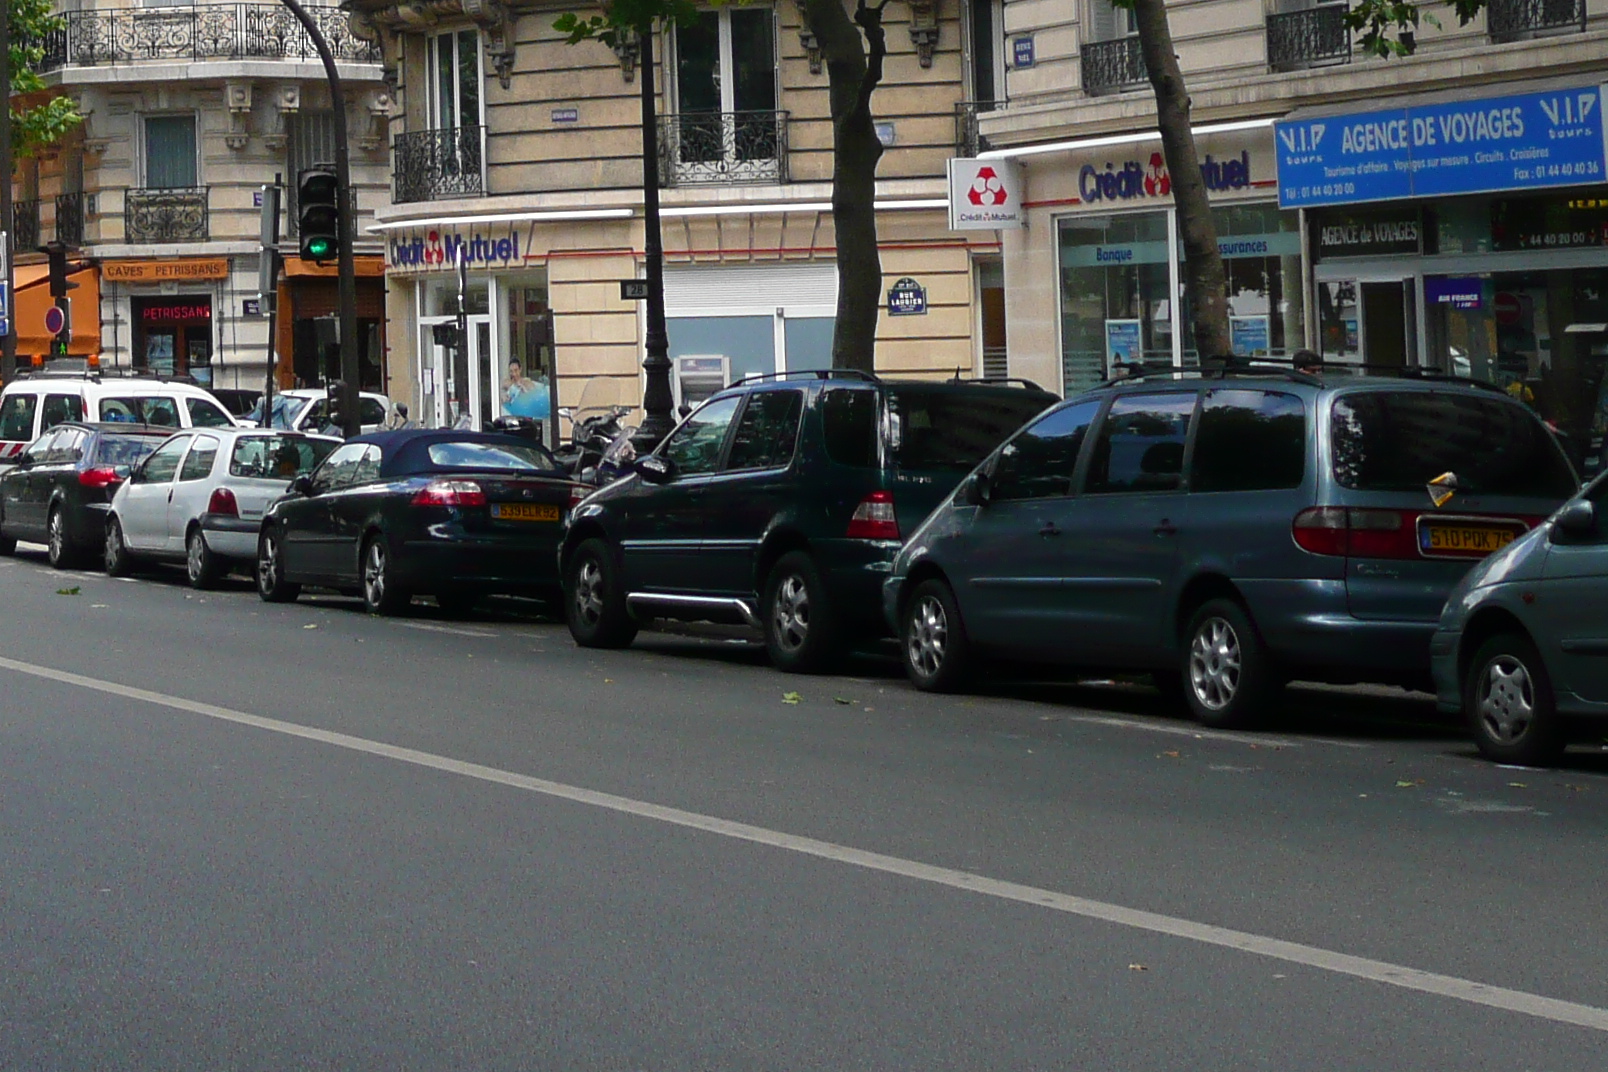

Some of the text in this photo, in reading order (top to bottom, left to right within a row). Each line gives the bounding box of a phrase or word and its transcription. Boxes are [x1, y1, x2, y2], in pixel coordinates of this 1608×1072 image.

[1342, 106, 1525, 154] AGENCE DE VOYAGES
[1548, 127, 1593, 139] tours
[1286, 154, 1323, 165] tours
[1475, 150, 1504, 164] Circuits
[1079, 150, 1251, 203] Crédit tuel
[1514, 167, 1529, 180] Fax
[1548, 164, 1559, 176] 44
[1561, 163, 1572, 176] 40
[1574, 162, 1585, 175] 40
[1587, 161, 1599, 174] 36
[1312, 186, 1322, 197] 44
[1323, 185, 1333, 196] 40
[1334, 184, 1343, 195] 20
[1344, 183, 1355, 194] 00
[960, 211, 1016, 222] Crédit Mutuel
[1321, 221, 1417, 245] AGENCE de VOYAGES
[1530, 235, 1542, 246] 44
[1544, 234, 1556, 245] 40
[1572, 232, 1585, 243] 00
[444, 231, 519, 263] Mutuel
[1218, 240, 1267, 255] ssurances
[1096, 246, 1133, 263] Banque
[107, 264, 220, 277] CAVES PETRISSANS
[1451, 294, 1478, 302] FRANCE
[143, 306, 210, 319] PETRISSANS
[1431, 529, 1460, 546] 510
